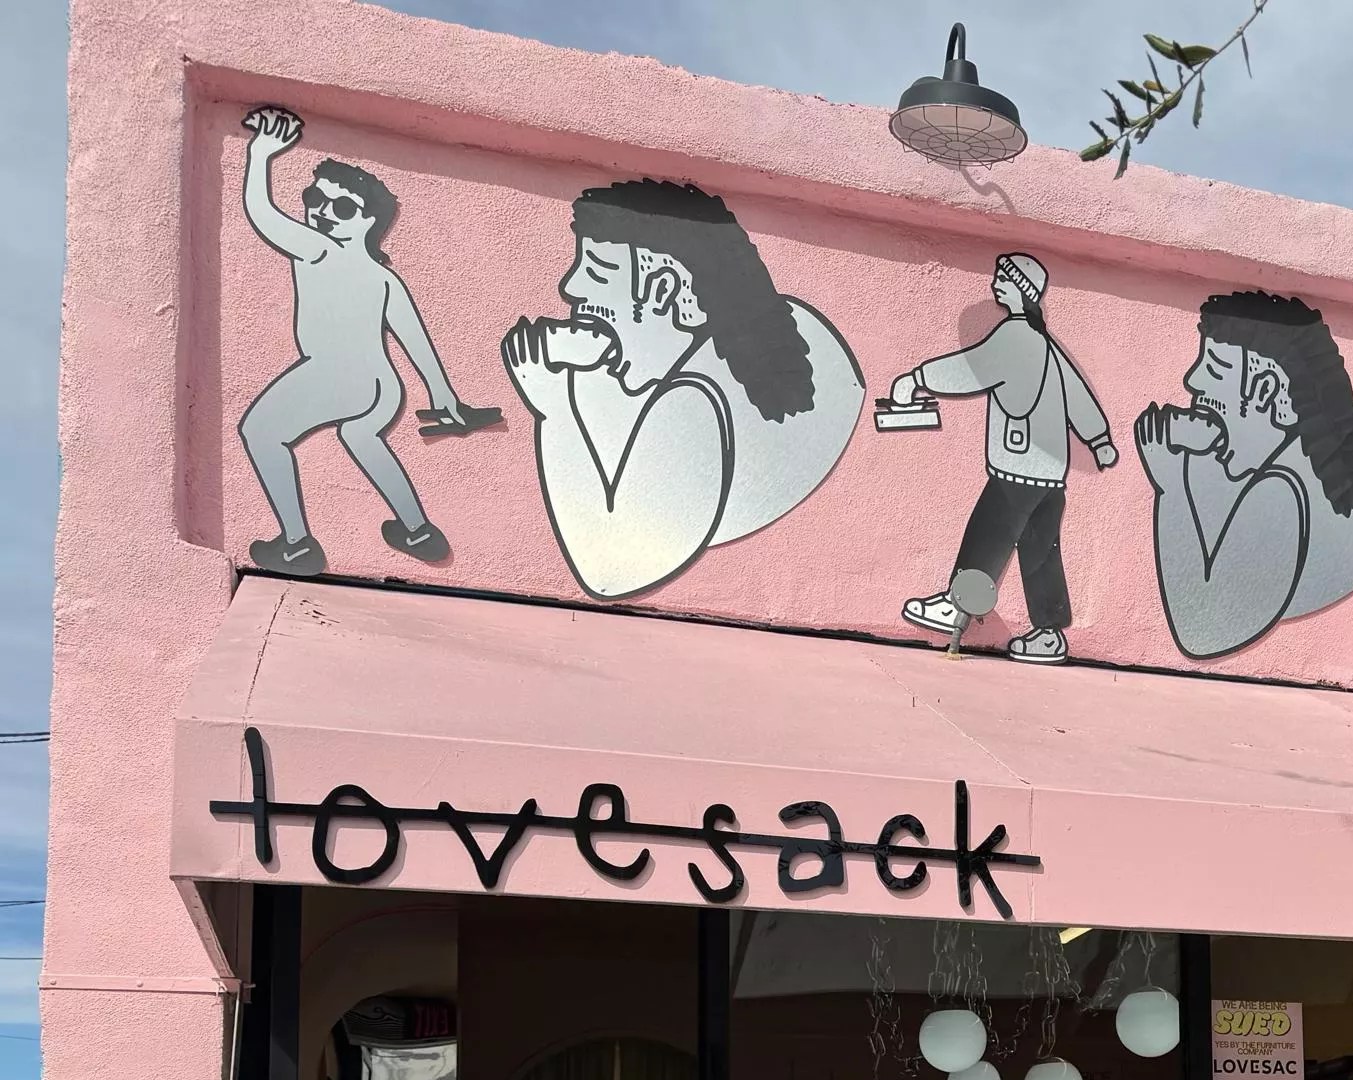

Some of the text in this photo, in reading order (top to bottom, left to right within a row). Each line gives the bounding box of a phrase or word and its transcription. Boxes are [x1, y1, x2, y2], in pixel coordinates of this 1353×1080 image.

[243, 727, 1014, 920] lovesack
[1222, 1000, 1287, 1010] WE ARE BEING
[1213, 1009, 1292, 1036] SUED
[1215, 1041, 1296, 1050] YES BY THE FURNITURE
[1213, 1059, 1297, 1075] LOVESAC
